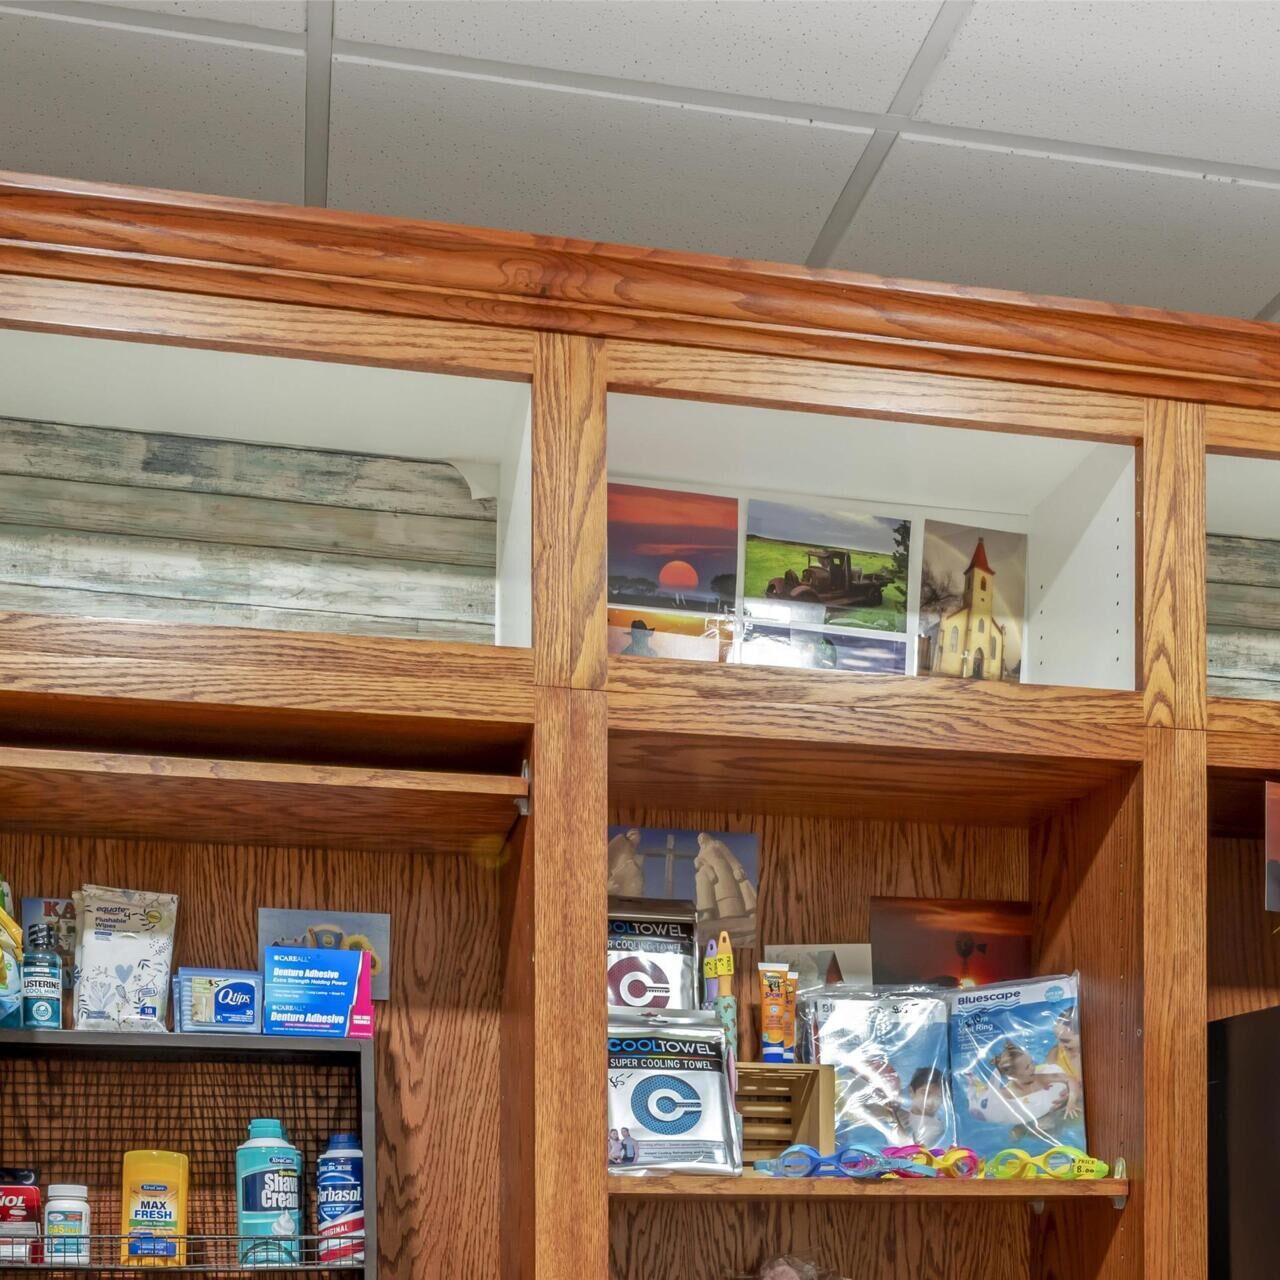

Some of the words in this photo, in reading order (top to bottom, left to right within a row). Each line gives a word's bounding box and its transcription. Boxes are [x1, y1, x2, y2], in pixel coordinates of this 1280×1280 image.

[96, 906, 126, 914] equate
[608, 921, 687, 937] OLTOWEL
[273, 968, 303, 977] Denture
[304, 969, 339, 978] Adhesive
[24, 980, 60, 990] LISTERINE
[958, 990, 1021, 1006] Bluescape
[271, 1012, 305, 1021] Denture
[306, 1013, 344, 1023] Adhesive
[976, 1023, 993, 1031] Ring
[608, 1038, 716, 1056] COOLTOWEL
[610, 1058, 638, 1068] SUPER
[641, 1059, 680, 1069] COOLING
[684, 1061, 712, 1070] TOWEL
[318, 1187, 362, 1202] arbasol
[141, 1201, 166, 1210] MAX
[134, 1209, 172, 1219] FRESH
